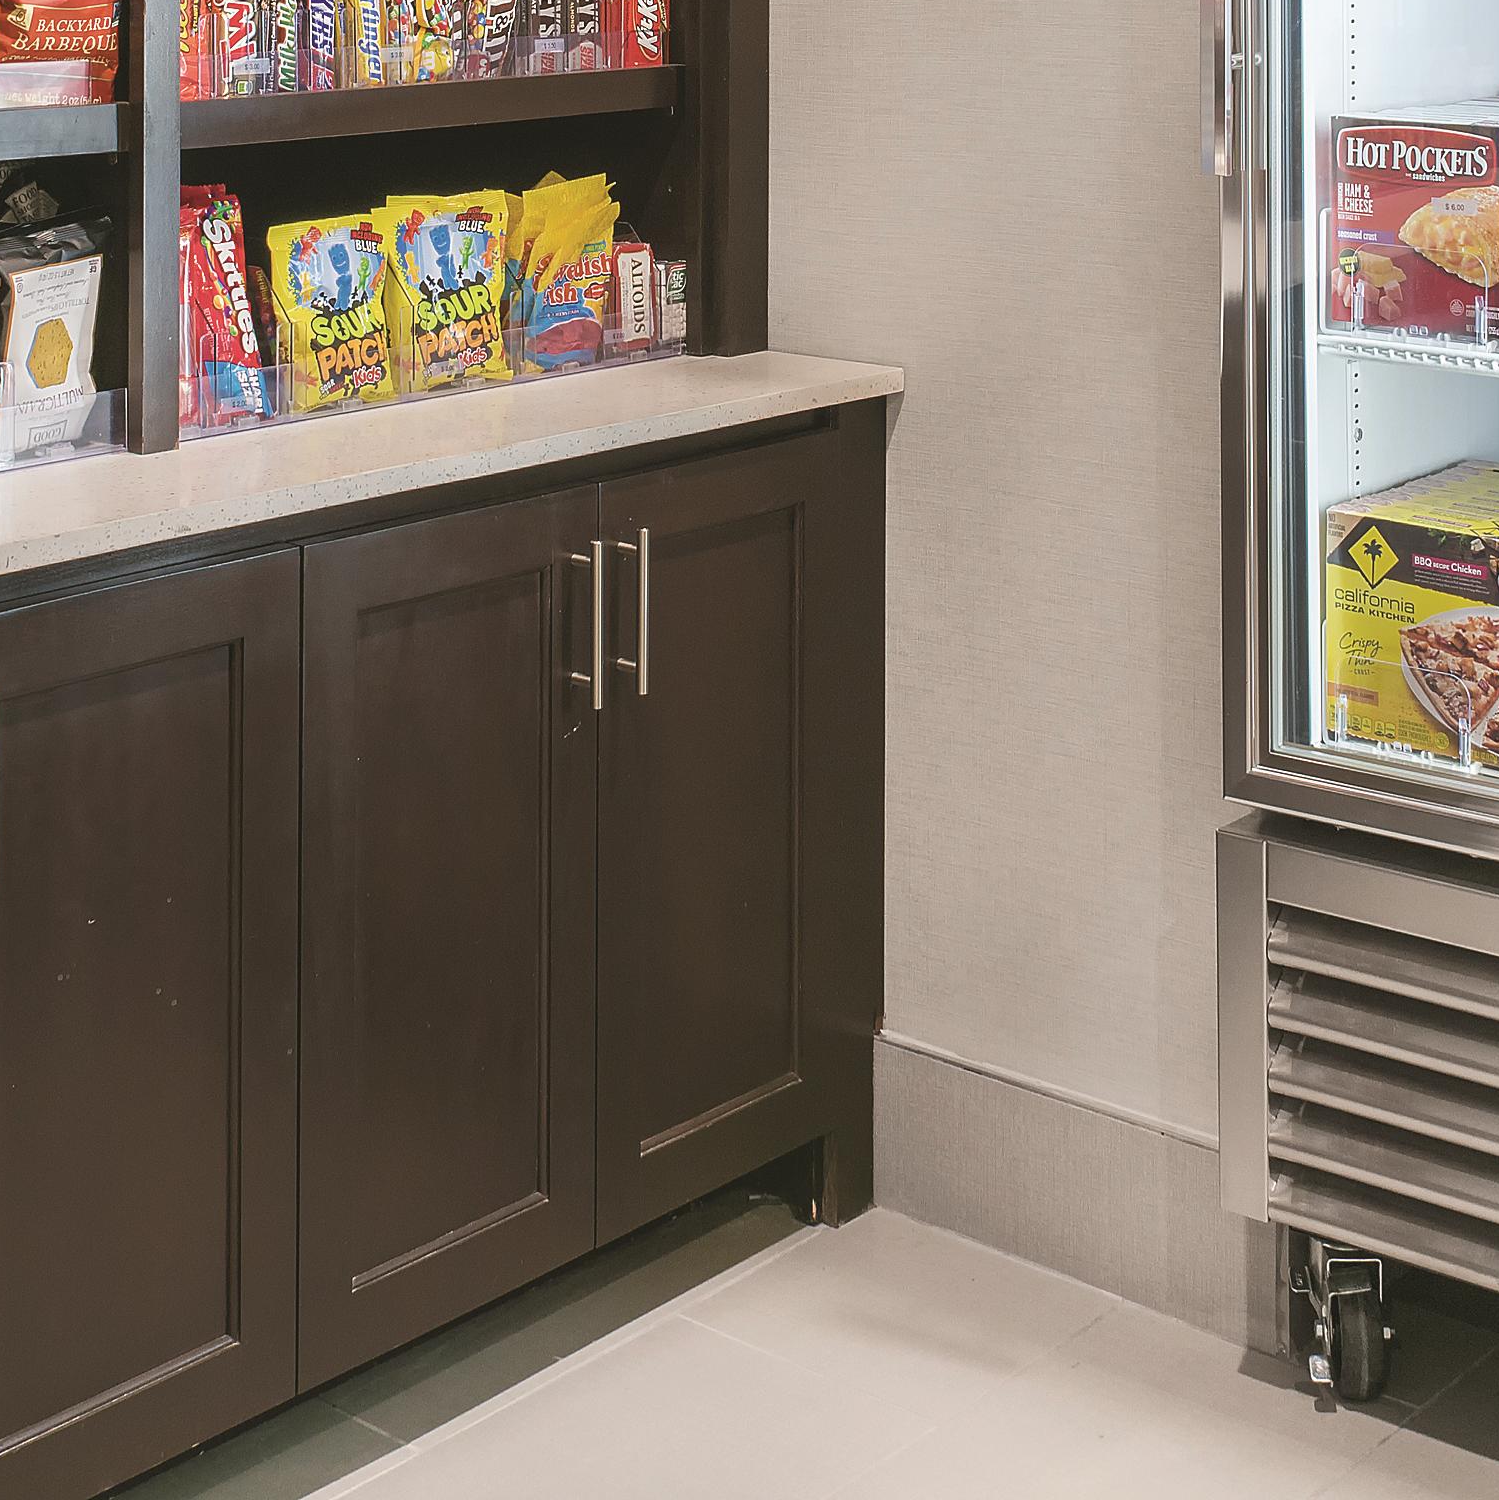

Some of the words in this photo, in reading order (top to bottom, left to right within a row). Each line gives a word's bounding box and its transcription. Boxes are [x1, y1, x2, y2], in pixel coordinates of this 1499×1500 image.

[36, 16, 111, 32] BACKYARD
[12, 32, 117, 51] BARBEQUE
[1346, 137, 1389, 169] HOT
[1392, 141, 1488, 177] POCKETS
[1412, 174, 1445, 182] sandwiches
[1345, 184, 1362, 199] HAM
[1364, 185, 1370, 199] &
[1345, 197, 1373, 214] CHEESE
[459, 221, 484, 233] BLUE
[1338, 230, 1362, 240] seasoned
[1363, 231, 1377, 241] crust
[355, 239, 378, 253] BLUE
[203, 218, 258, 354] Skittles
[630, 259, 646, 335] ALTOIDS
[417, 285, 491, 330] SOUR
[312, 303, 382, 346] SOUR
[417, 314, 499, 363] PATCH
[317, 331, 387, 380] PATCH
[458, 348, 487, 367] Kids
[1414, 557, 1432, 568] BBQ
[1433, 562, 1450, 571] RECIPE
[1451, 563, 1482, 576] Chicken
[1335, 587, 1415, 614] california
[1335, 602, 1364, 614] PIZZA
[1369, 610, 1414, 624] KITCHEN
